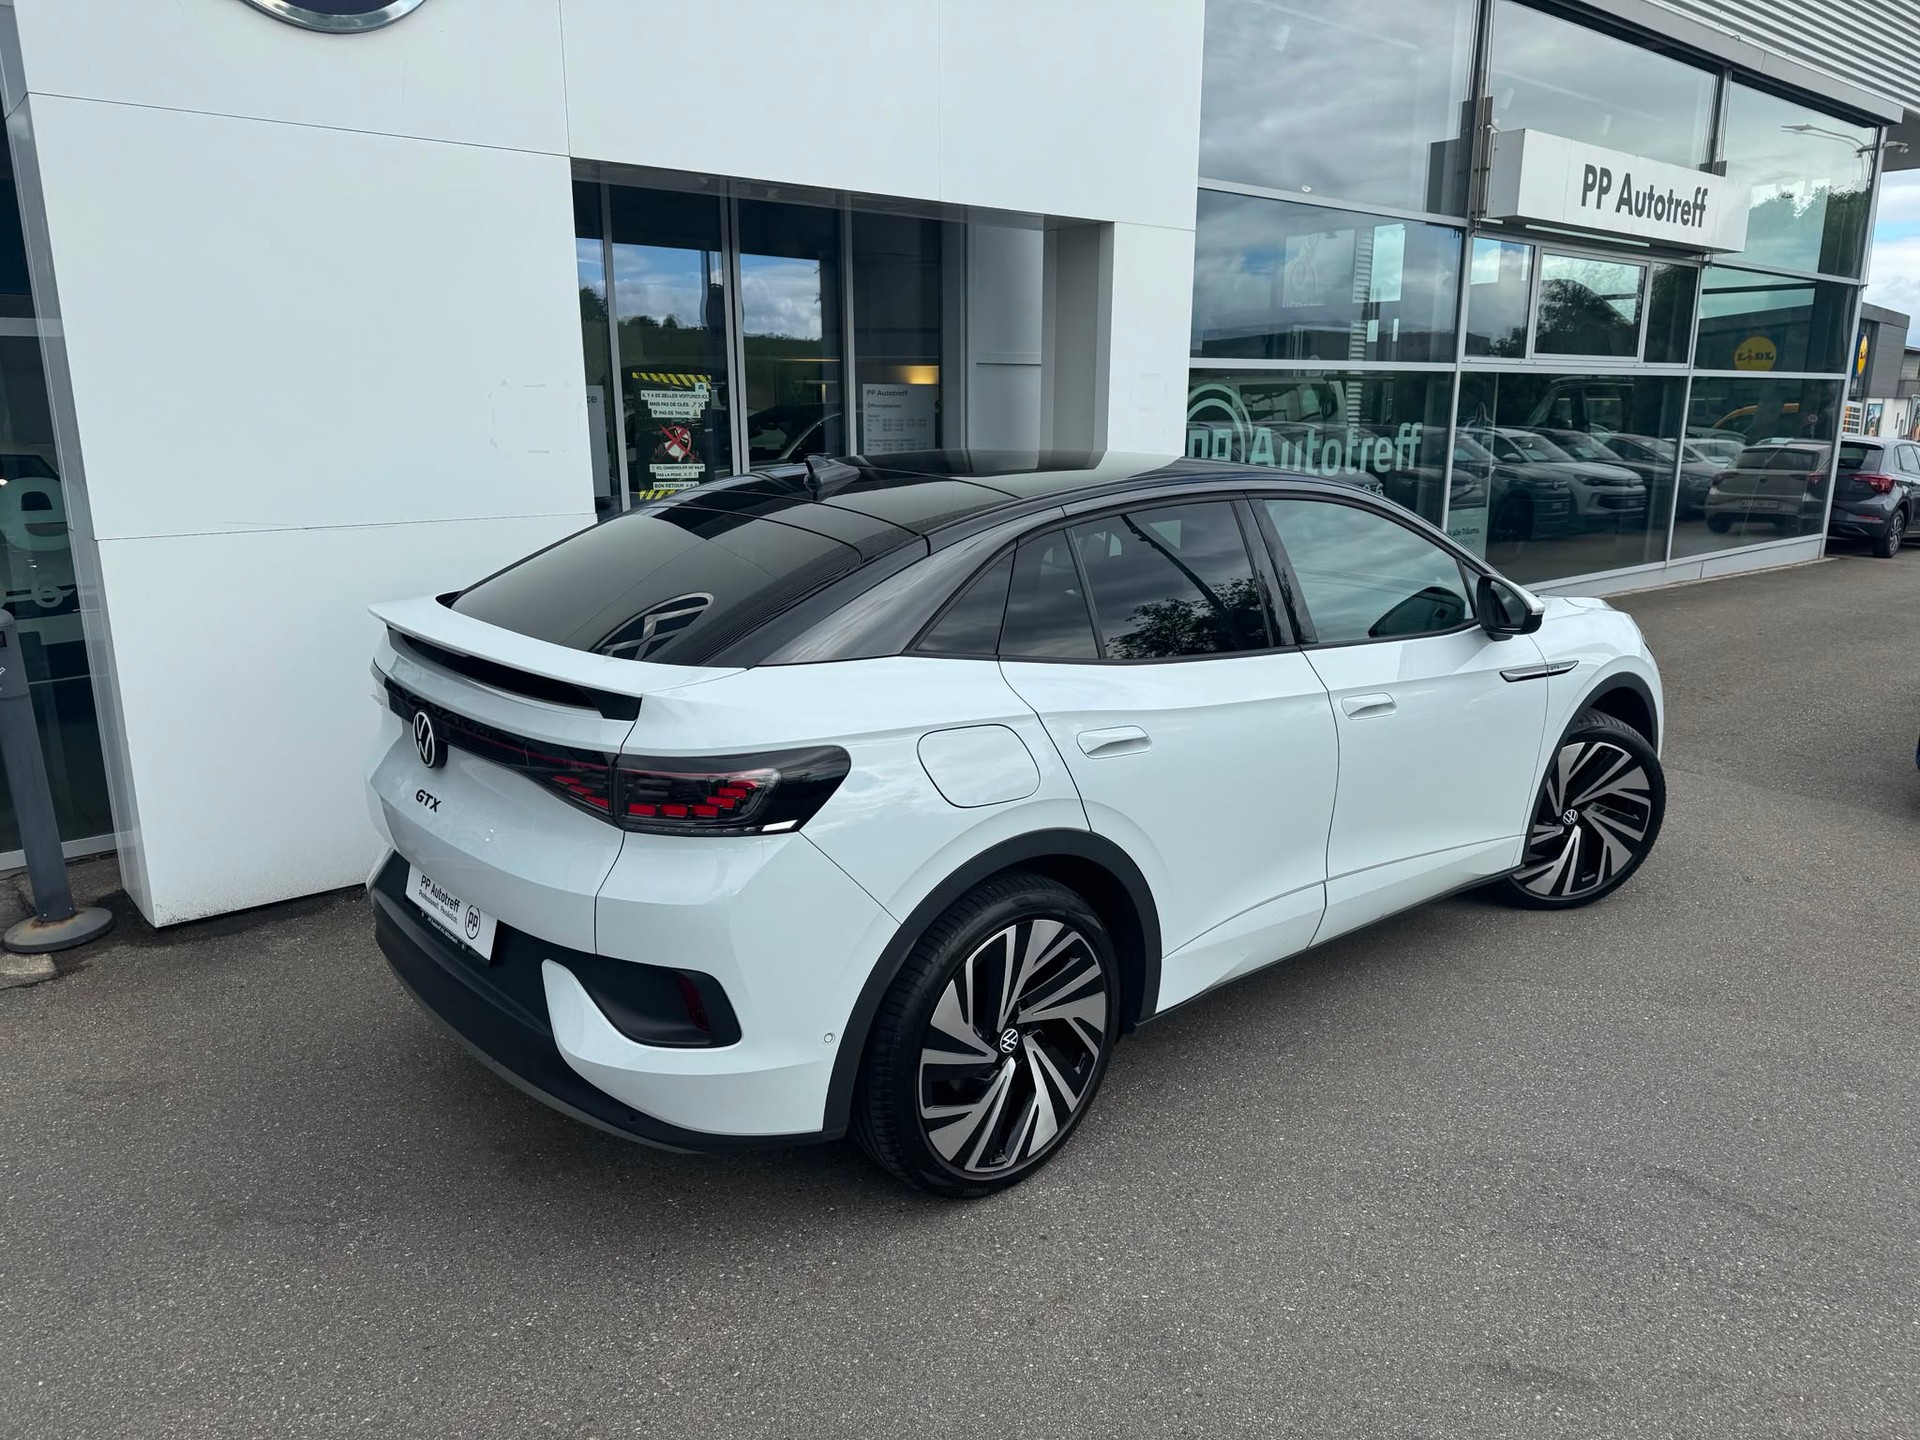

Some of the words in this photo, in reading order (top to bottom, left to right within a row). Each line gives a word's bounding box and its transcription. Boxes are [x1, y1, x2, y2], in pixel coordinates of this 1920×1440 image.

[1581, 163, 1612, 210] PP
[1615, 172, 1709, 228] Autotreff
[877, 389, 908, 397] Autotreff
[1249, 422, 1423, 476] Autotreff
[415, 789, 442, 813] GTX
[421, 874, 431, 890] PP
[430, 883, 461, 913] Autotreff
